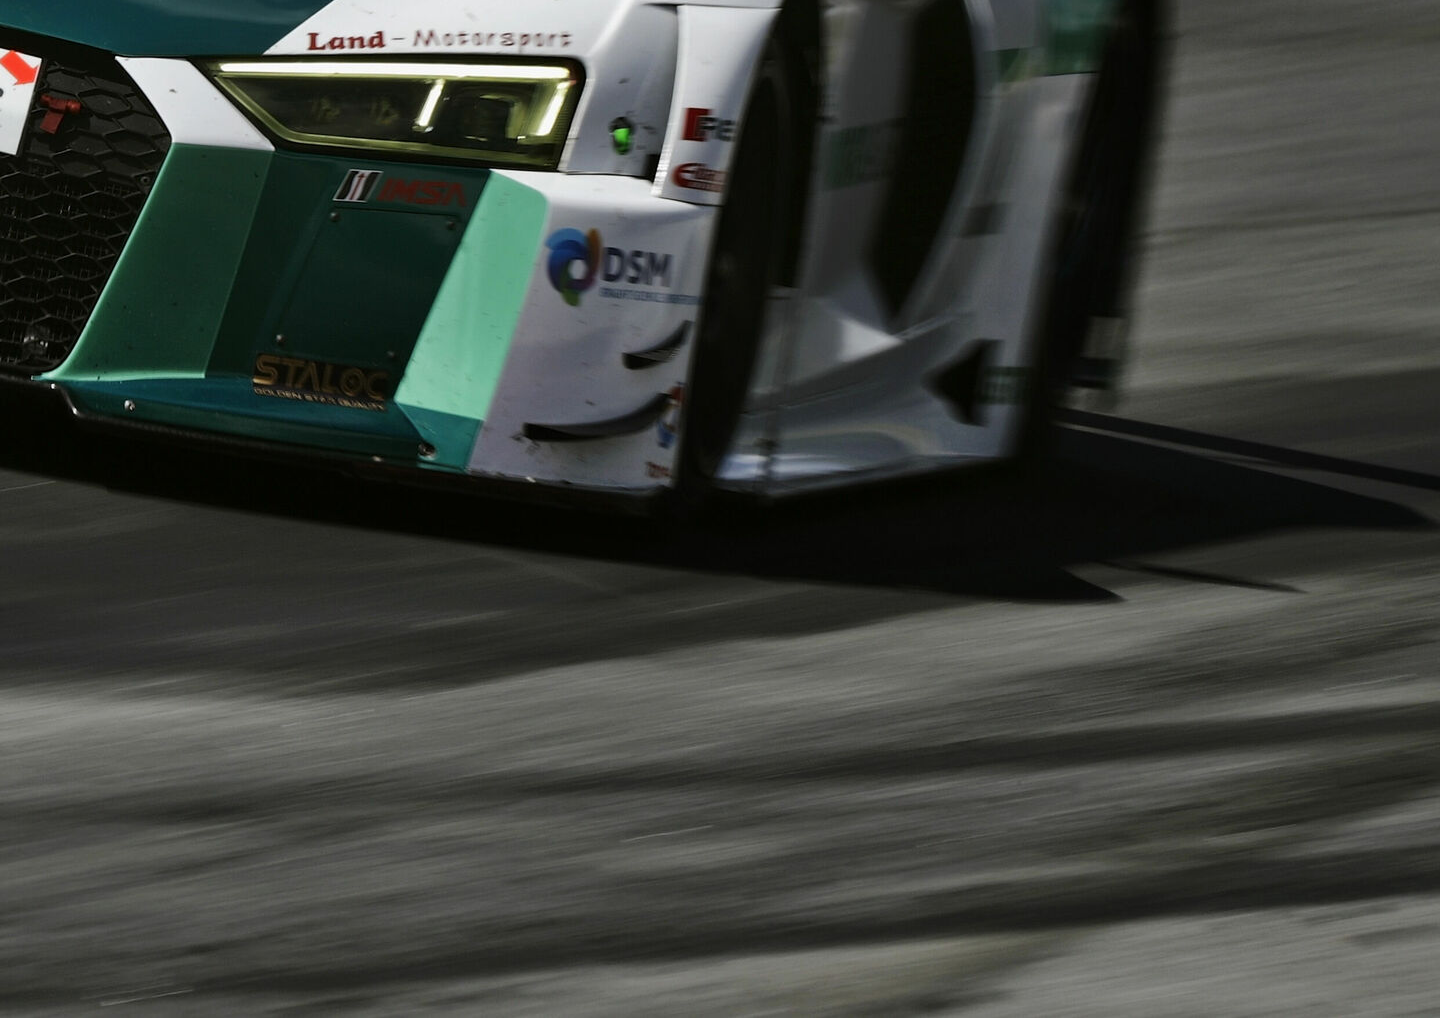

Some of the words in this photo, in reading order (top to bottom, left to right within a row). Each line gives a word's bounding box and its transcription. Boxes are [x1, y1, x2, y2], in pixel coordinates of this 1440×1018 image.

[307, 30, 387, 52] Land
[412, 28, 574, 54] Motorsport
[377, 176, 468, 207] IMSA
[602, 246, 674, 288] DSM
[251, 353, 388, 402] STALOC
